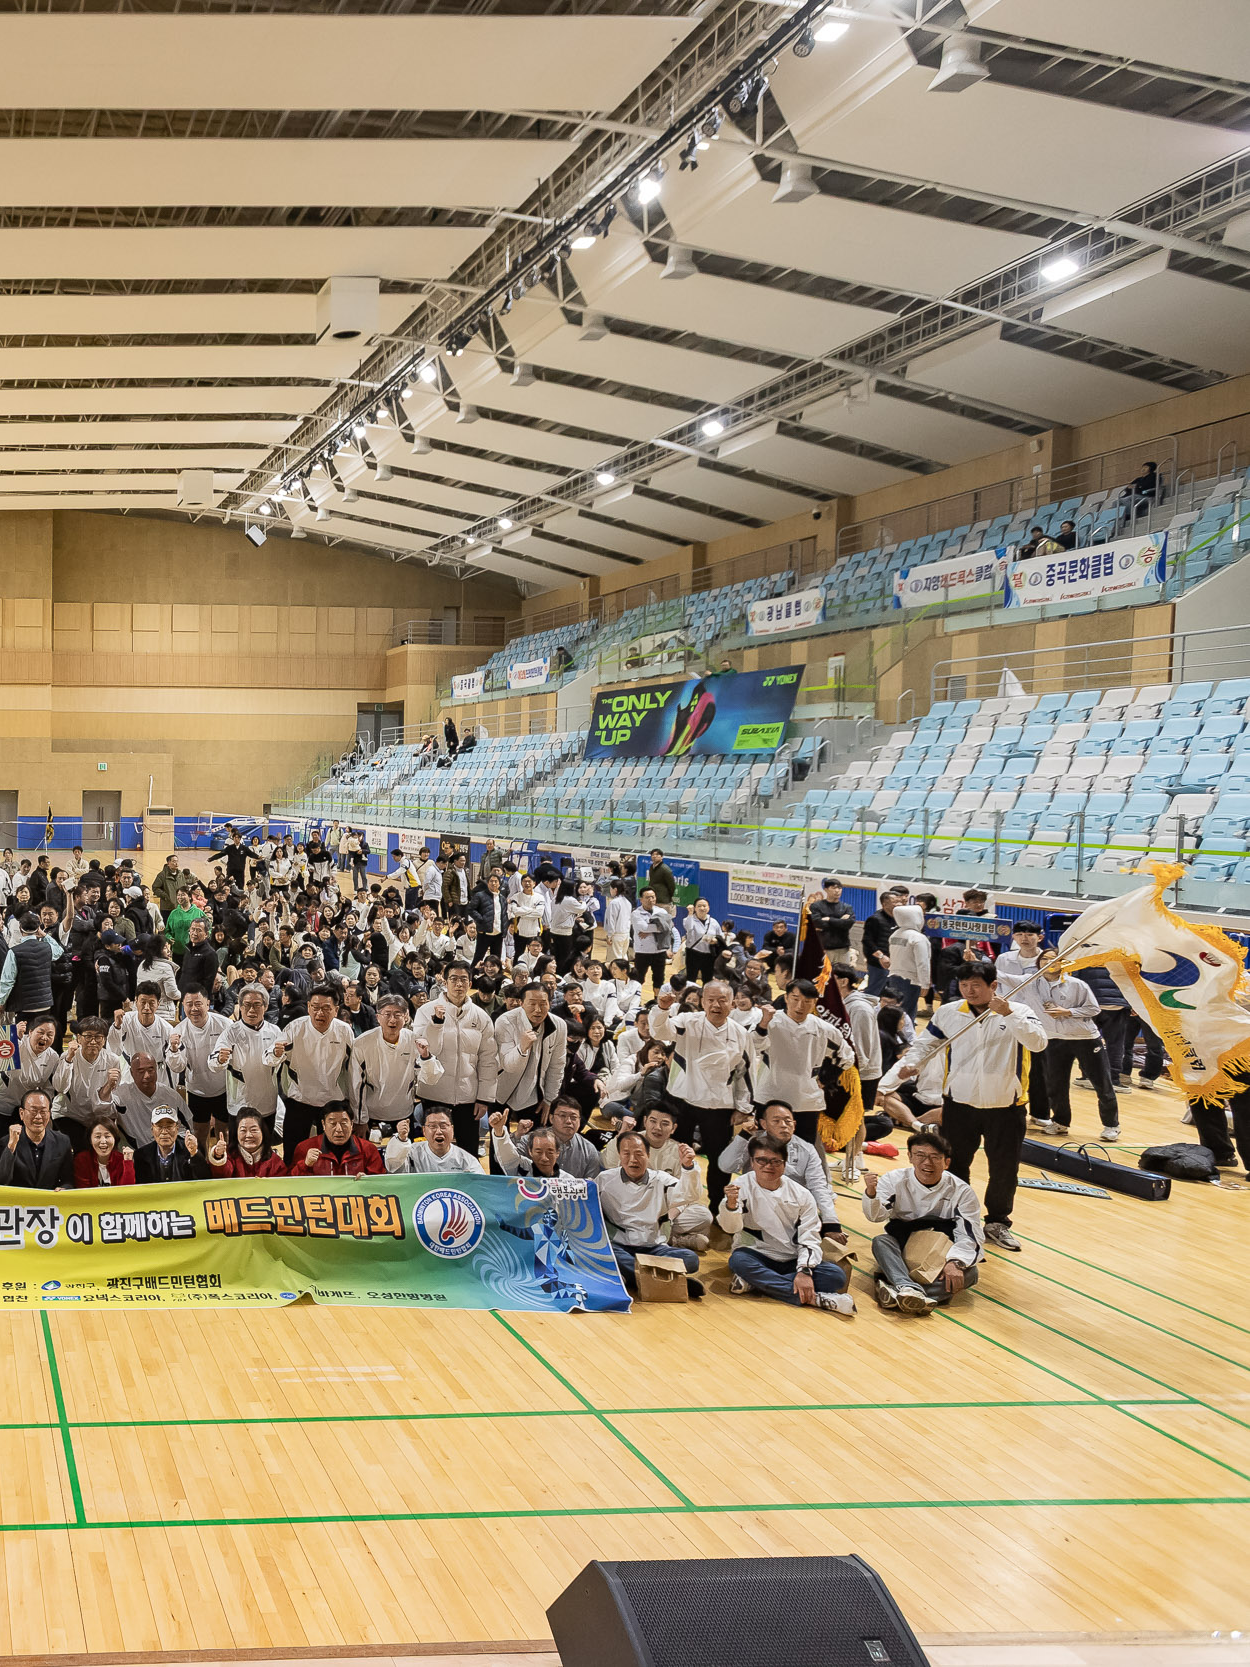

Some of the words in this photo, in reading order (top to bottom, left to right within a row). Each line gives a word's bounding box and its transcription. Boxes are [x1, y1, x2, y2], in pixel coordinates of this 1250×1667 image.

[1045, 551, 1115, 587] 중곡문화클럽
[612, 690, 673, 712] ONLY
[598, 710, 649, 730] WAY
[600, 729, 631, 746] UP
[67, 1213, 93, 1244] 이
[100, 1211, 196, 1243] 함께하는
[204, 1195, 406, 1240] 배드민턴대회
[416, 1197, 432, 1224] BADMINTON
[432, 1192, 452, 1200] KOREA
[453, 1193, 482, 1225] ASSOCIATION
[2, 1282, 27, 1290] 후원
[106, 1274, 222, 1290] 광진구배드민턴협회
